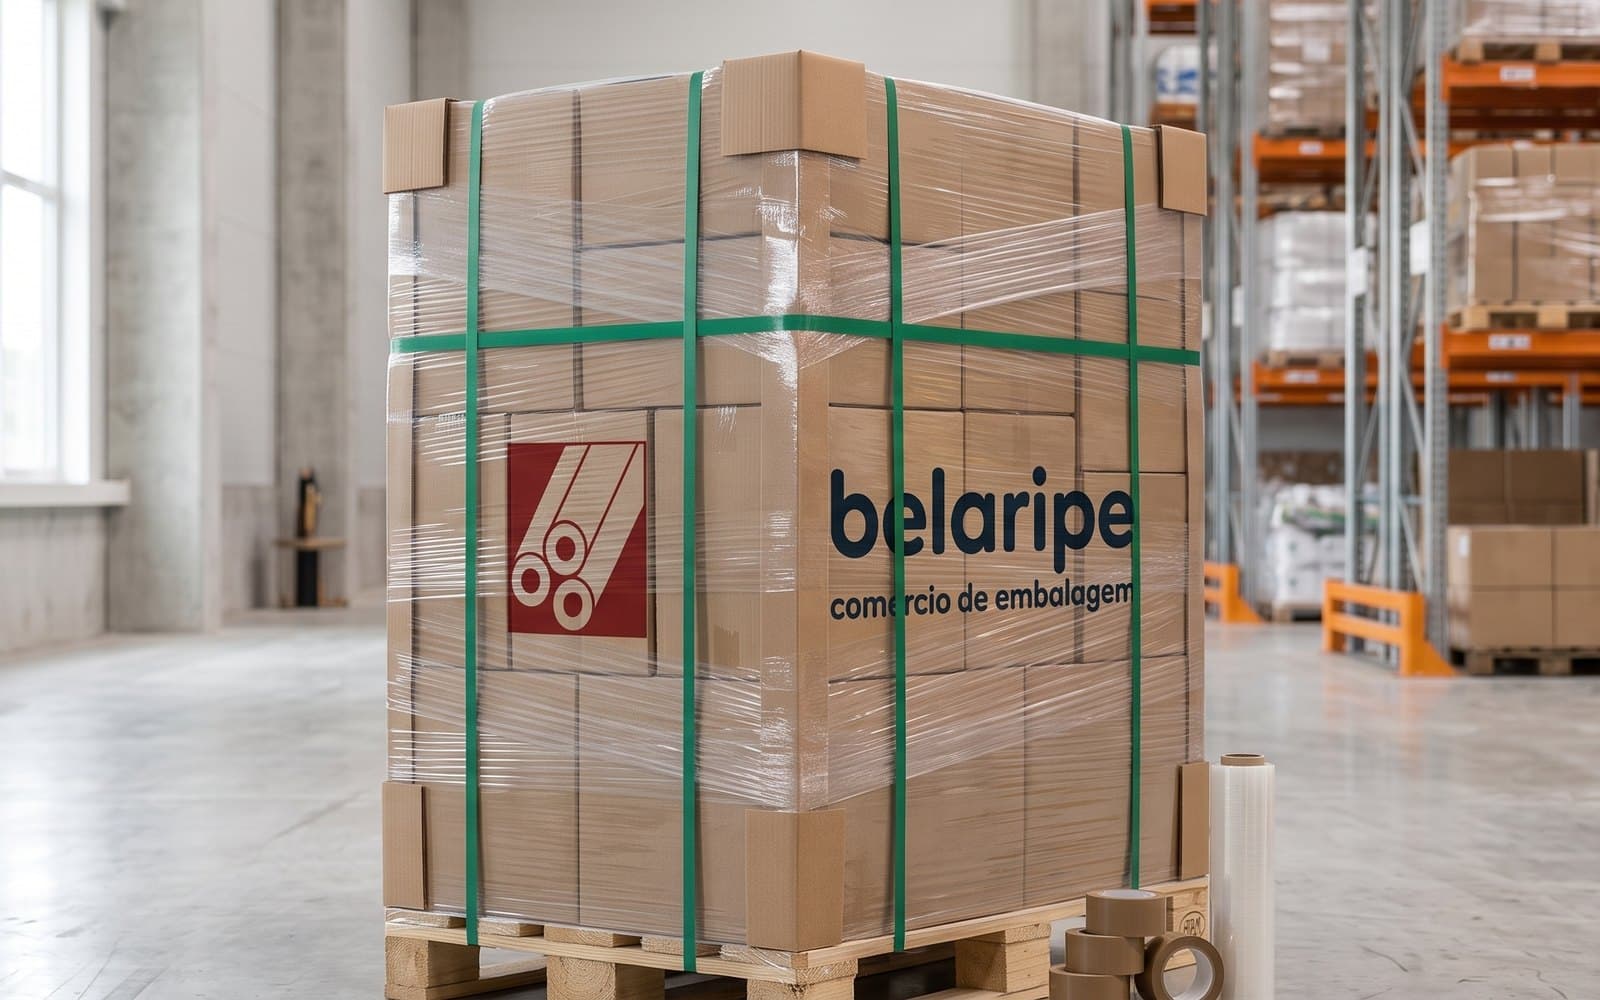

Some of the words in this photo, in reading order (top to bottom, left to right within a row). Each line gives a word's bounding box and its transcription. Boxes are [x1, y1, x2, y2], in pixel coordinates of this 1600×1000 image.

[831, 466, 1133, 574] belaripe
[958, 583, 988, 613] de
[995, 578, 1133, 612] embalagem
